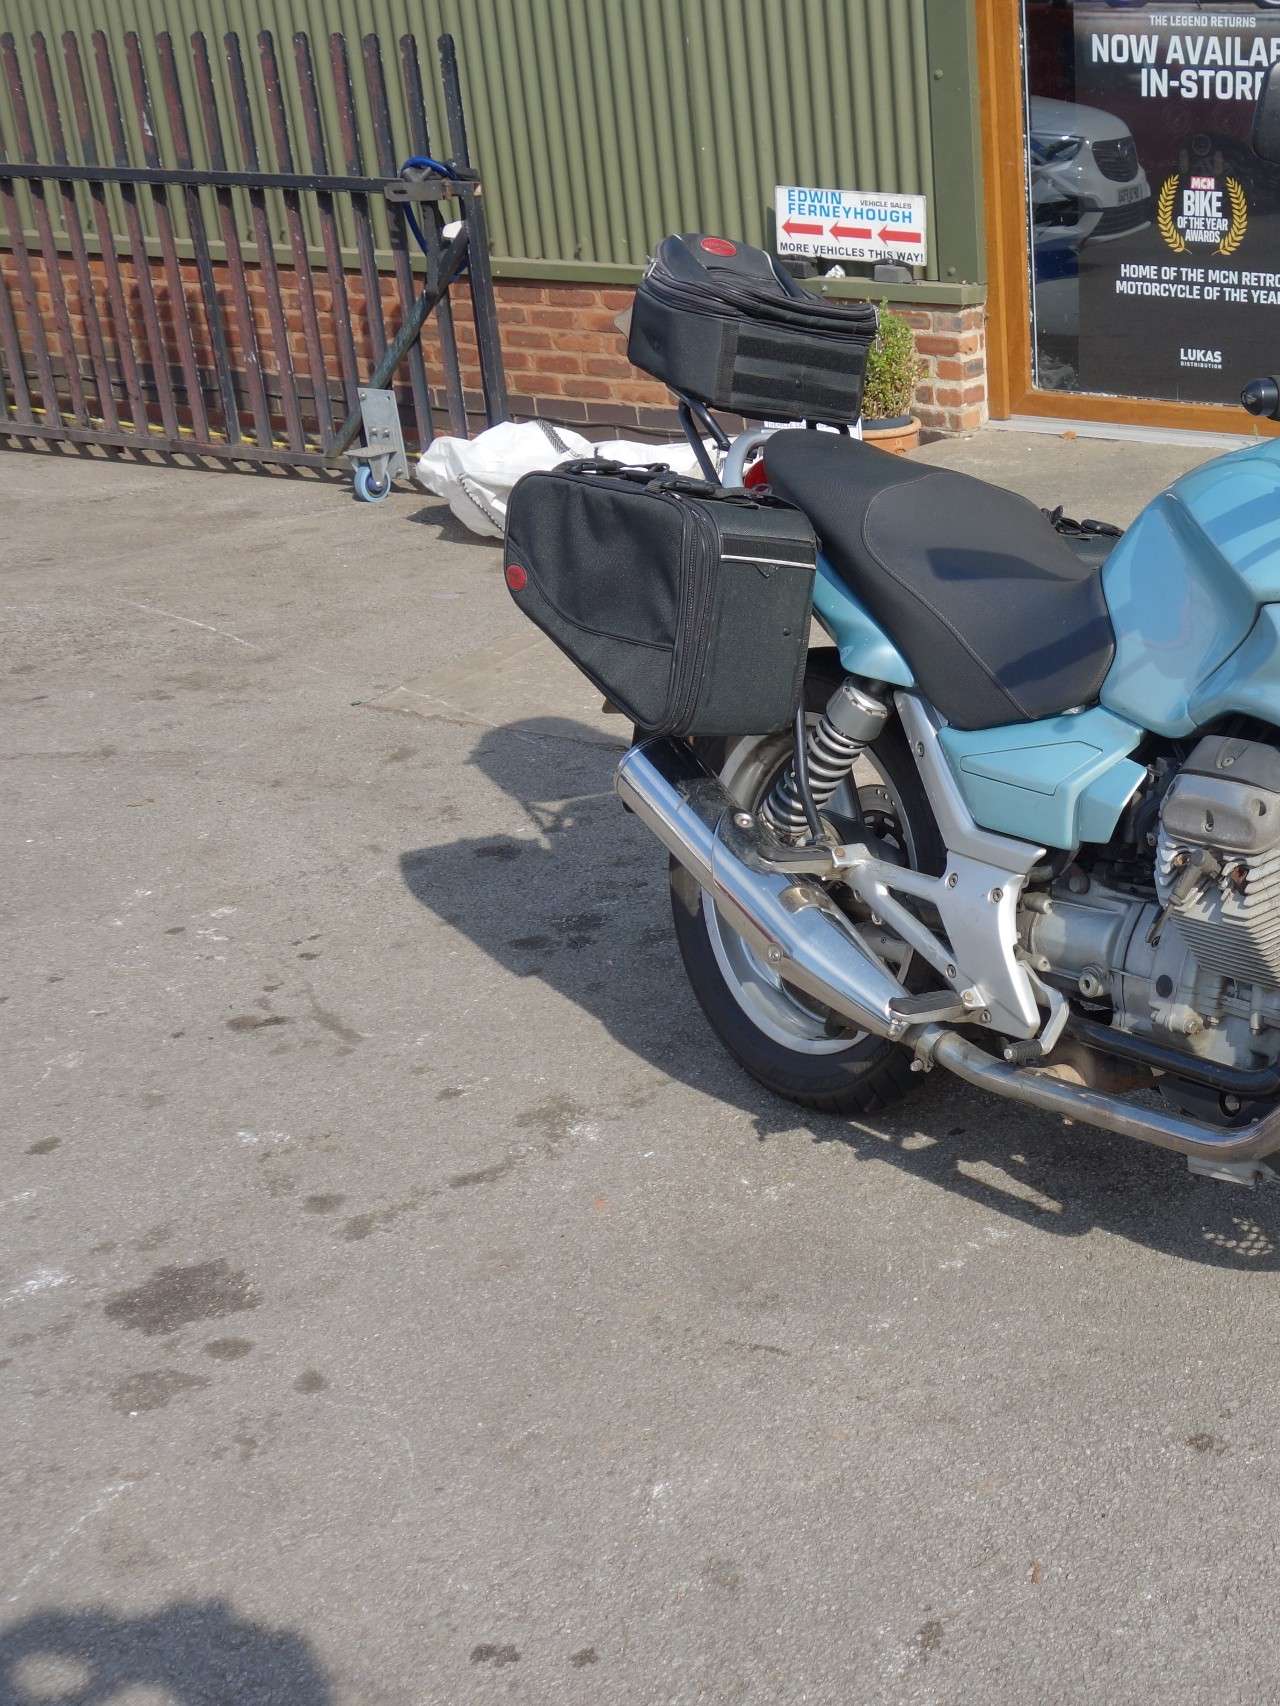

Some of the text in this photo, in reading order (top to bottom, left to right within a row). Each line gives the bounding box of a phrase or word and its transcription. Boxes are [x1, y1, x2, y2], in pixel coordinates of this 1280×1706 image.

[1150, 15, 1256, 28] THE LEGEND RETURNS
[1091, 33, 1159, 64] NOW
[788, 189, 842, 204] EDWIN
[859, 200, 912, 210] VEHICLE SALES
[1183, 189, 1223, 218] BIKE
[788, 203, 912, 224] FERNEYHOUGH
[1177, 216, 1229, 231] OF THE YEAR
[1185, 229, 1220, 243] AWARDS
[780, 242, 924, 263] MORE VEHICLES THIS WAY!
[1120, 263, 1158, 280] HOME
[1161, 266, 1178, 280] OF
[1180, 267, 1205, 283] THE
[1208, 269, 1238, 285] MCN
[1115, 280, 1201, 299] MOTORCYCLE
[1203, 286, 1221, 300] OF
[1223, 287, 1249, 303] THE
[1180, 348, 1222, 363] LUKAS
